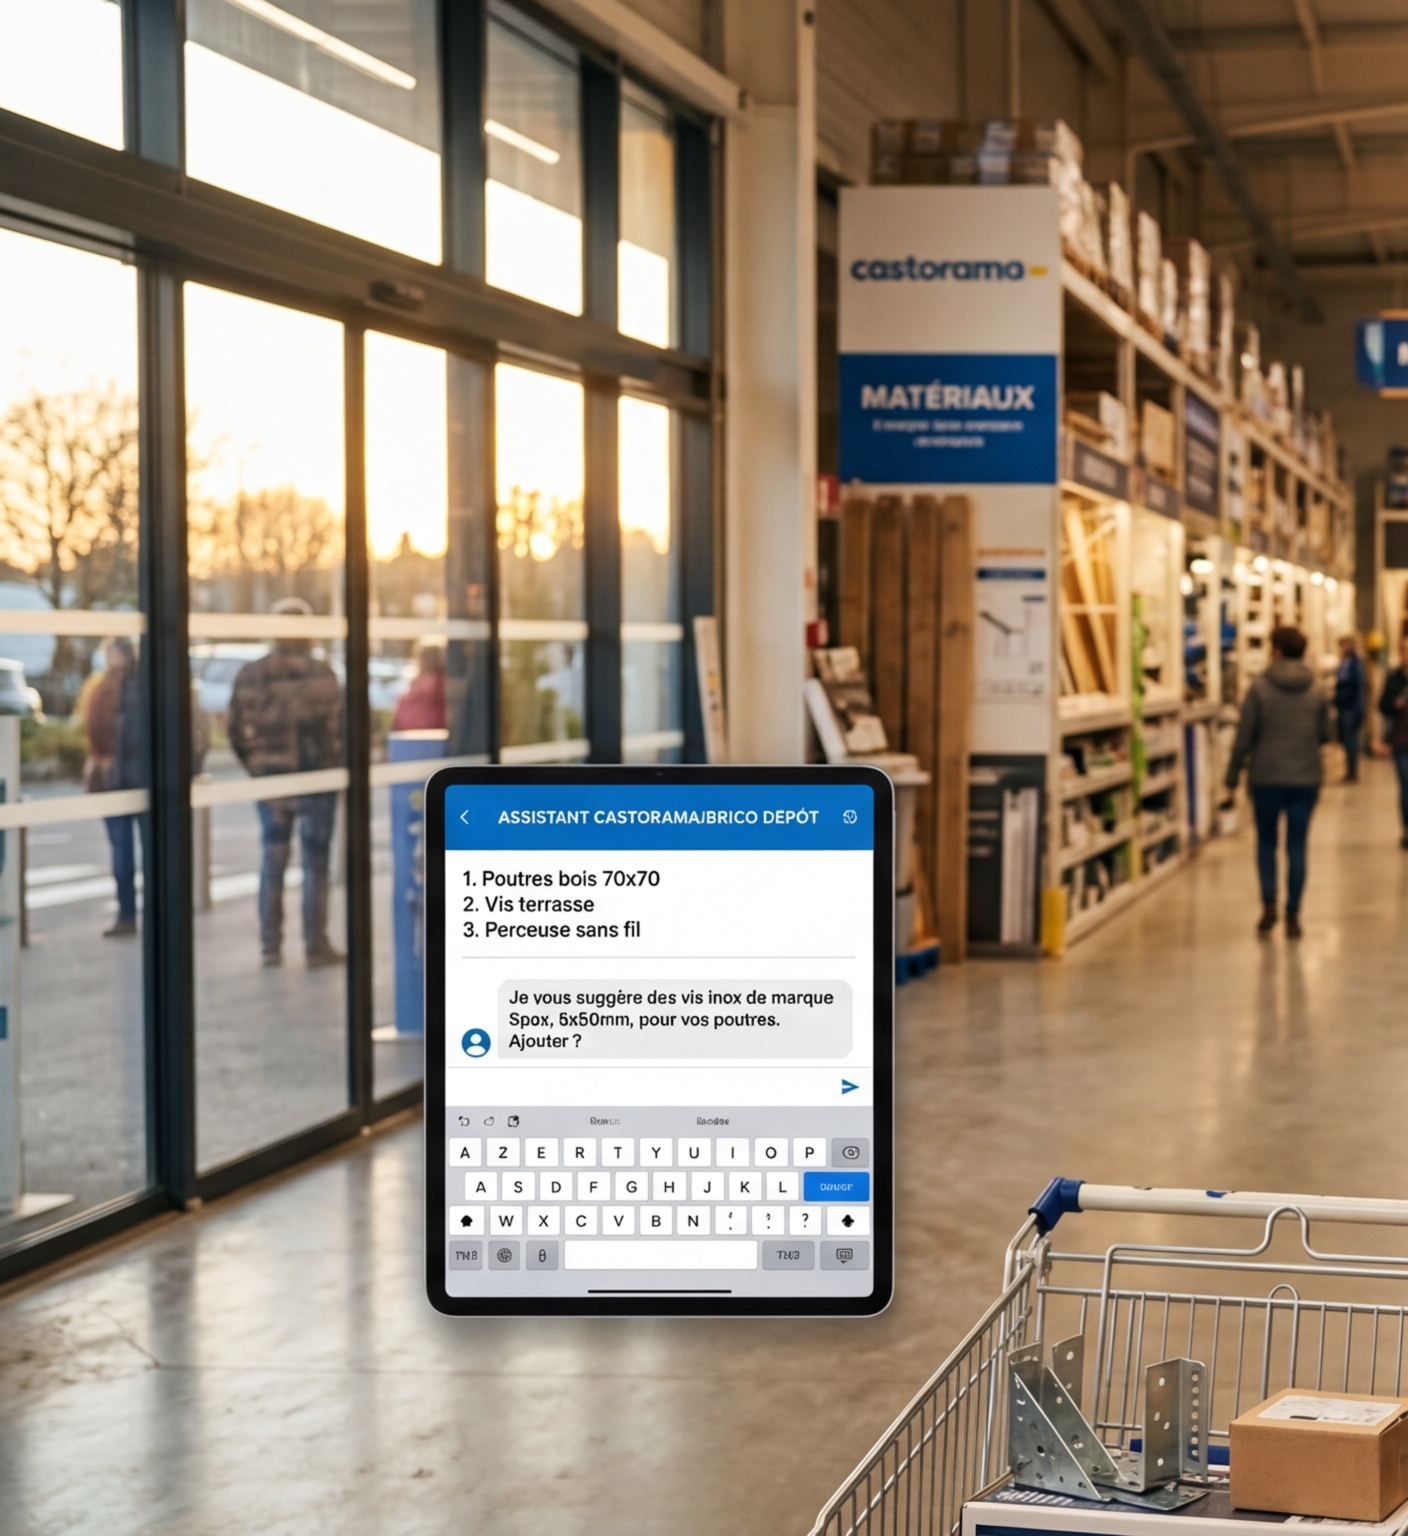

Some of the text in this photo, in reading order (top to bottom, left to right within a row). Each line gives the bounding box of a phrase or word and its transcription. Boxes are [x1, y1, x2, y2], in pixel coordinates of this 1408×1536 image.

[851, 255, 1025, 281] castorama
[861, 379, 1035, 410] MATÉRIAUX
[498, 810, 590, 824] ASSISTANT
[463, 870, 660, 887] 1. Poutres bois 70x70
[463, 895, 595, 913] 2. Vis terrasse
[463, 920, 641, 938] 3. Perceuse sans fil
[509, 990, 529, 1005] Je
[533, 993, 572, 1005] vous
[647, 989, 677, 1005] des
[681, 989, 704, 1005] vis
[708, 989, 742, 1005] inox
[746, 989, 767, 1005] de
[771, 993, 834, 1009] marque
[509, 1011, 554, 1030] Spox,
[639, 1015, 677, 1030] pour
[680, 1015, 710, 1027] vos
[713, 1013, 781, 1030] poutres.
[508, 1033, 582, 1052] Ajouter ?
[460, 1146, 471, 1159] A
[498, 1146, 508, 1159] Z
[537, 1146, 546, 1159] E
[575, 1146, 585, 1159] R
[614, 1146, 622, 1159] T
[651, 1147, 661, 1159] Y
[689, 1147, 700, 1159] U
[765, 1146, 777, 1159] O
[805, 1146, 815, 1159] P
[475, 1180, 787, 1194] A S D F G H J K L
[498, 1215, 514, 1227] W
[538, 1215, 549, 1227] X
[575, 1214, 587, 1228] C
[613, 1215, 624, 1227] V
[651, 1215, 661, 1228] B
[688, 1215, 699, 1227] N
